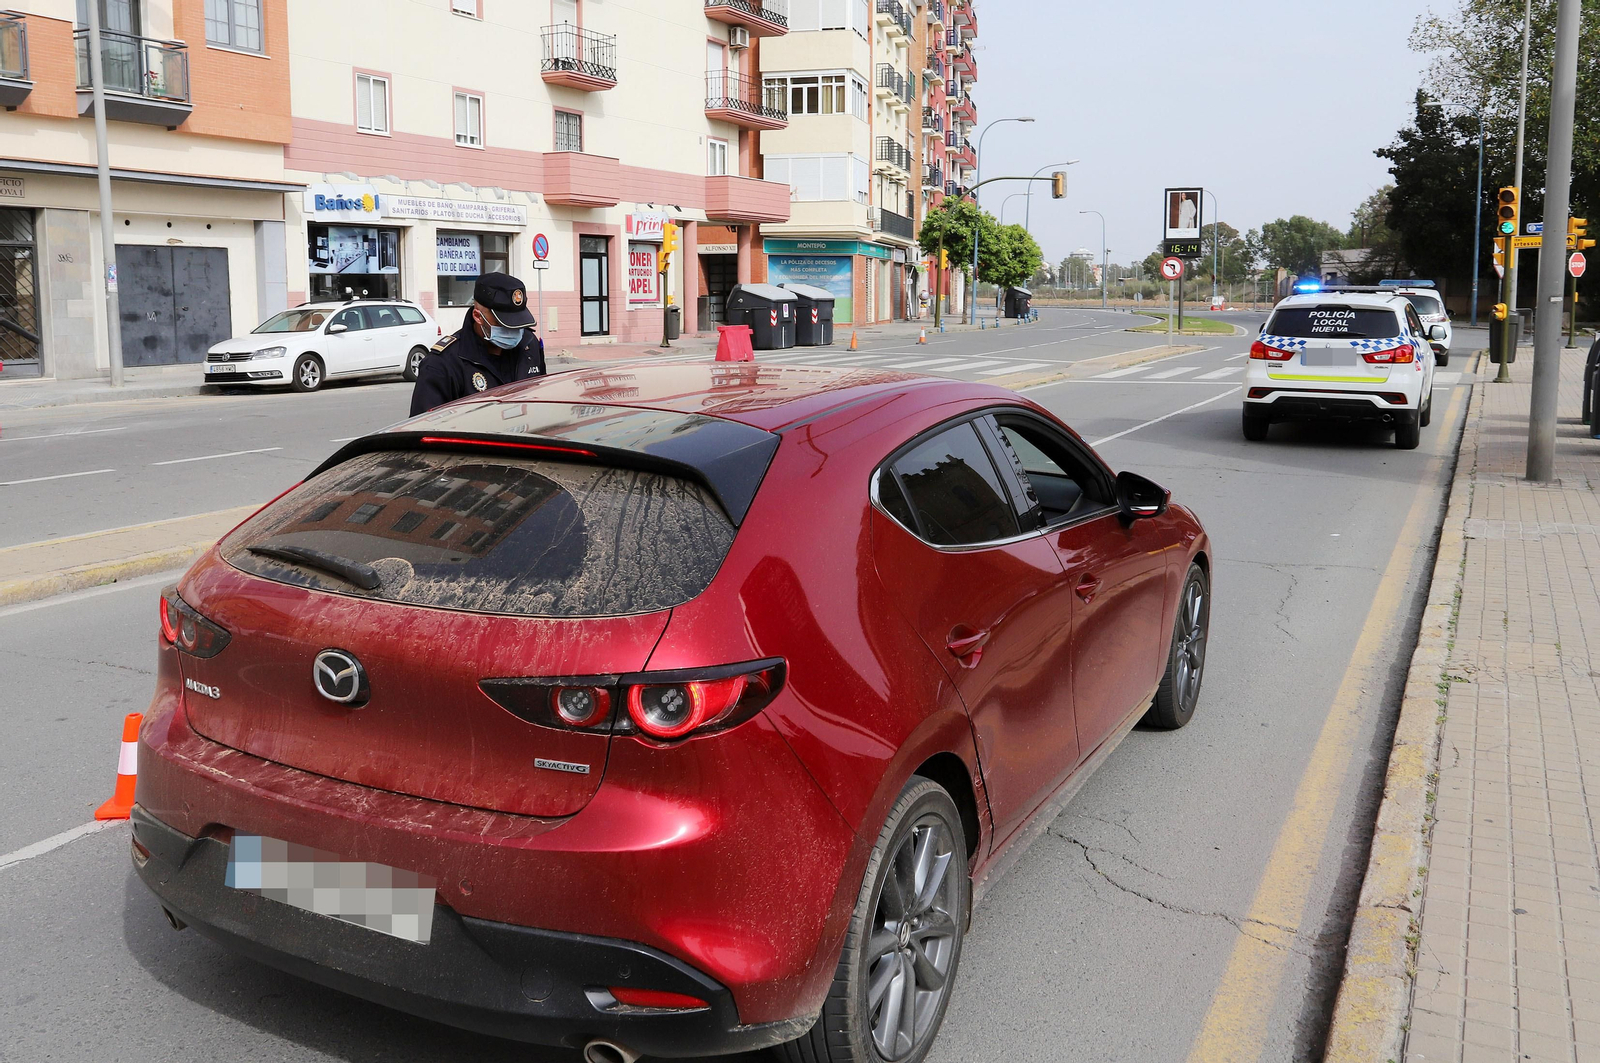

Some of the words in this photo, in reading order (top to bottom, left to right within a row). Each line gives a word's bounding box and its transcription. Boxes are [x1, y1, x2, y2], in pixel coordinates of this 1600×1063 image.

[392, 207, 429, 216] SANITARIOS
[436, 237, 470, 247] CAMBIAMOS
[1171, 244, 1197, 252] 16:14
[440, 248, 463, 259] BAÑERA
[465, 251, 476, 260] POR
[628, 248, 652, 266] ÓNER
[450, 263, 457, 271] DE
[459, 263, 477, 272] DUCHA
[629, 278, 652, 294] APEL
[1308, 310, 1356, 318] POLICÍA
